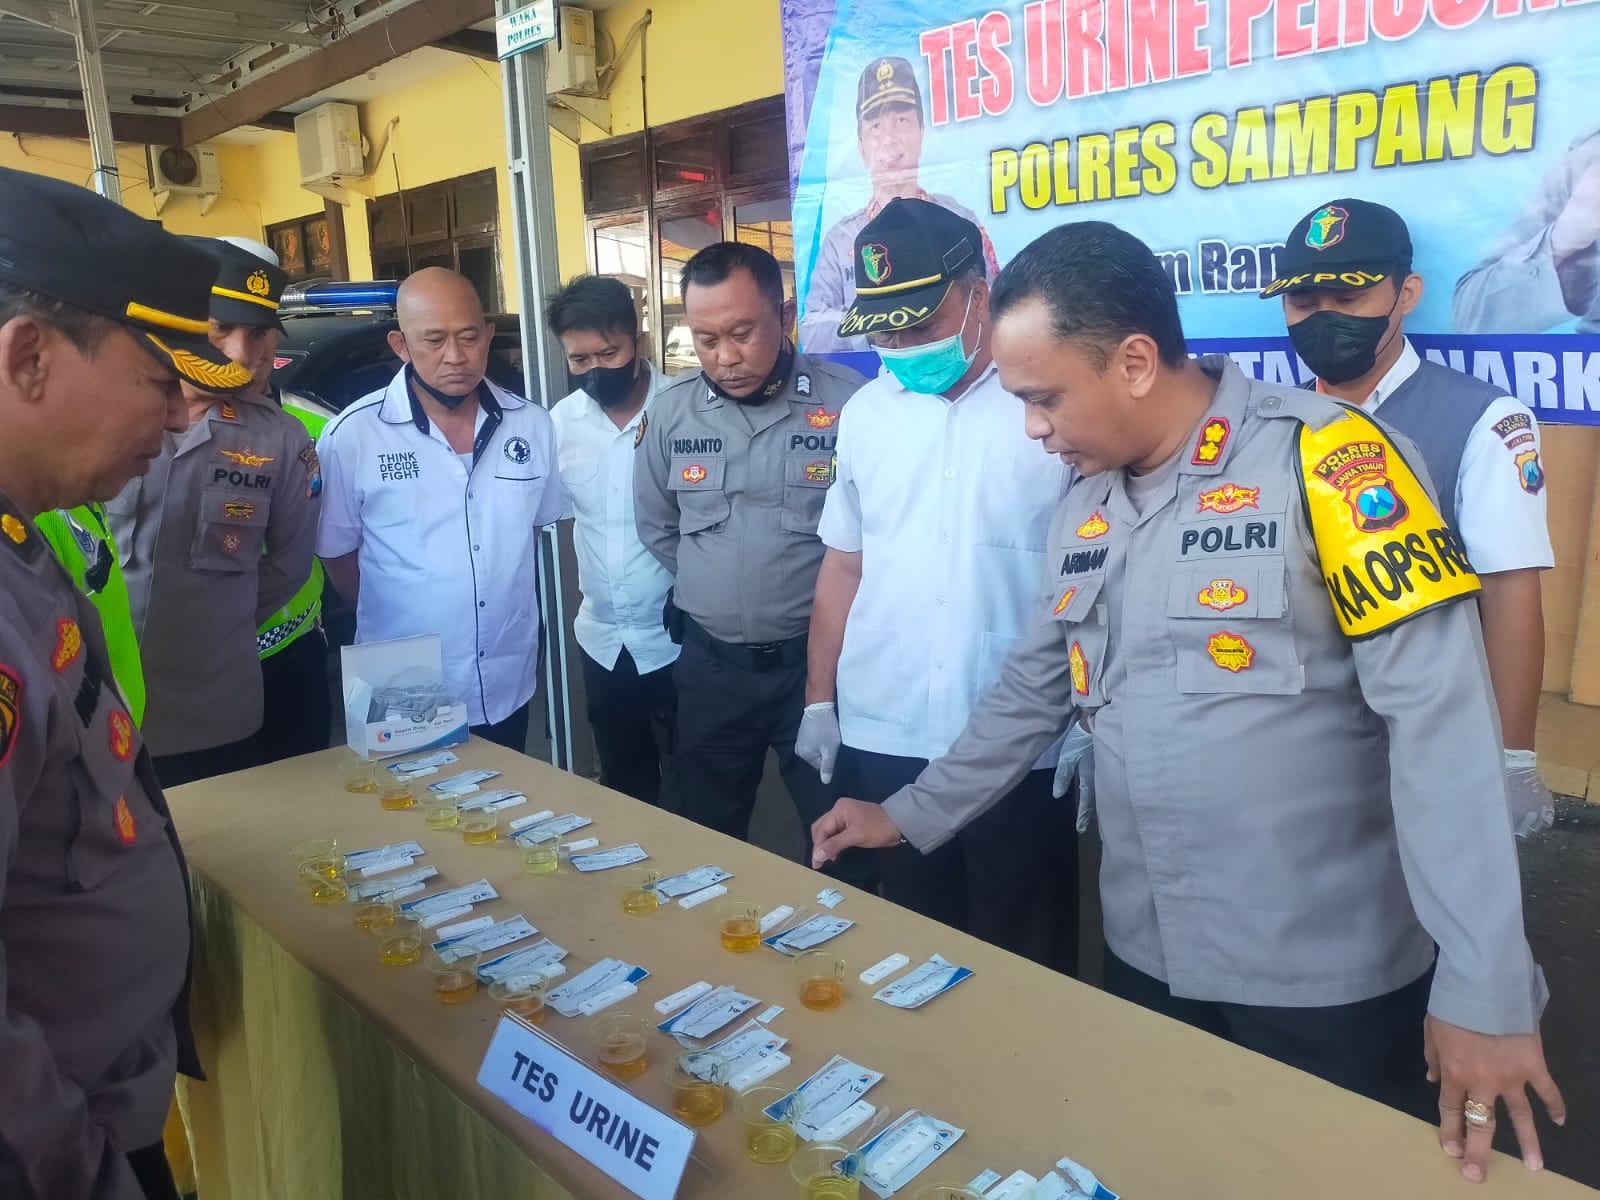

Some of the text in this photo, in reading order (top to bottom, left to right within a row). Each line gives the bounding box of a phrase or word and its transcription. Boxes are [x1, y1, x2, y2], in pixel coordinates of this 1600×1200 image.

[510, 7, 537, 28] WAKA
[507, 24, 542, 46] POLRES
[919, 11, 1015, 126] TES
[1023, 0, 1213, 107] URINE
[990, 62, 1540, 214] POLRES SAMPANG
[378, 451, 417, 464] THINK
[673, 438, 723, 454] SUSANTO
[1318, 443, 1381, 475] POLRES
[213, 467, 272, 489] POLRI
[379, 461, 420, 473] DECIDE
[381, 469, 420, 482] FIGHT
[1181, 520, 1278, 556] POLRI
[1060, 545, 1110, 577] ARMAN
[1326, 564, 1379, 627] KA
[1364, 532, 1443, 602] OPS
[510, 1050, 661, 1173] TES URINE
